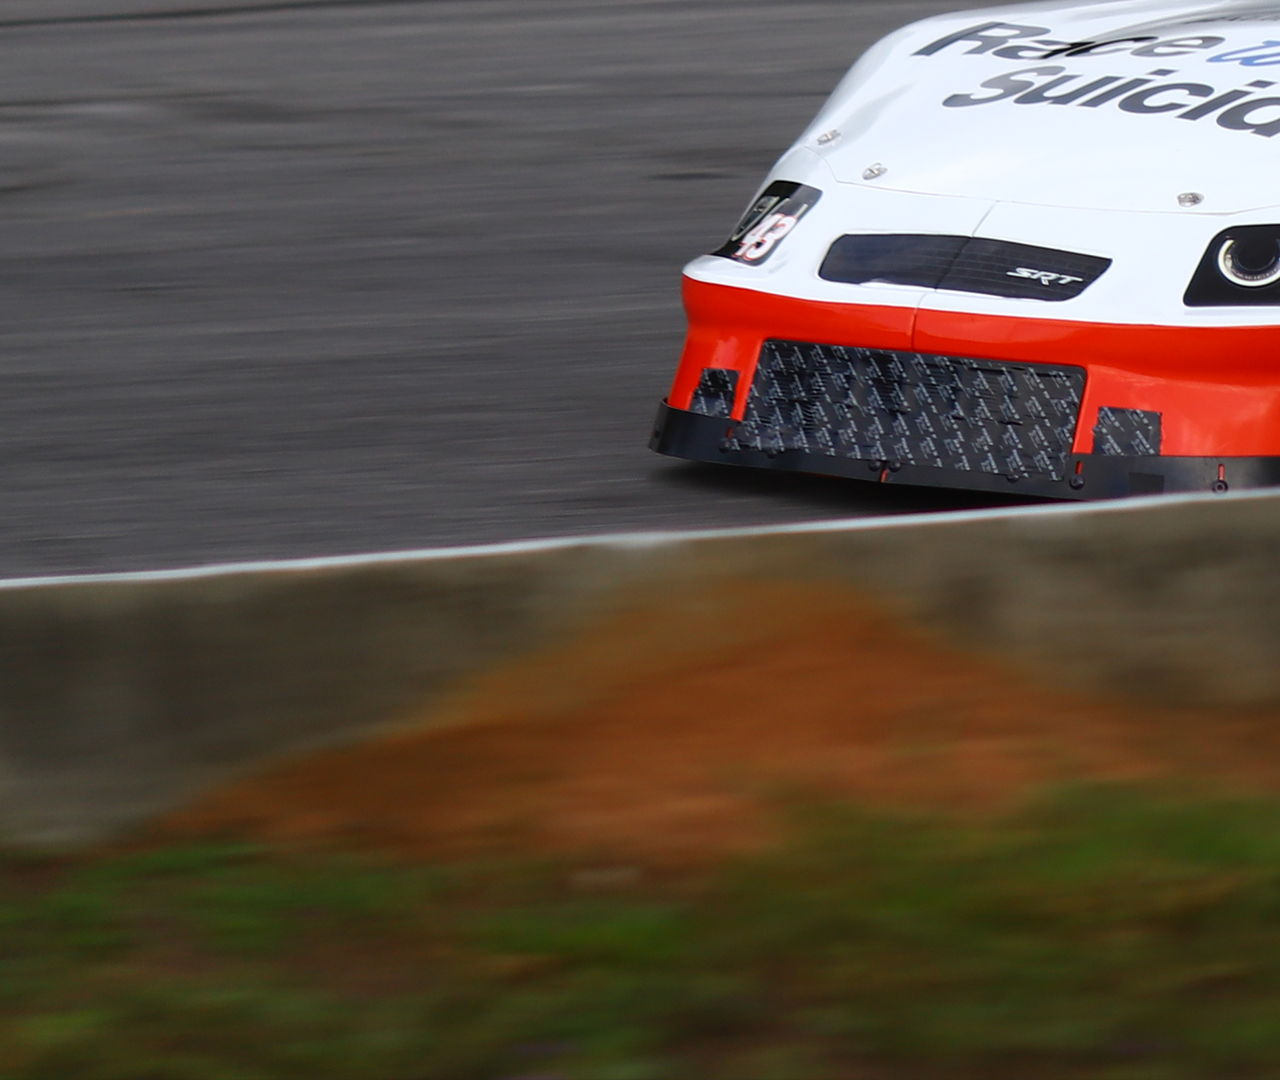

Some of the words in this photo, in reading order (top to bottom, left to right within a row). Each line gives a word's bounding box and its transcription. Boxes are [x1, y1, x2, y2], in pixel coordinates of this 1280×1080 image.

[912, 21, 1226, 62] Race
[733, 211, 799, 262] 43
[1005, 266, 1083, 286] SRT
